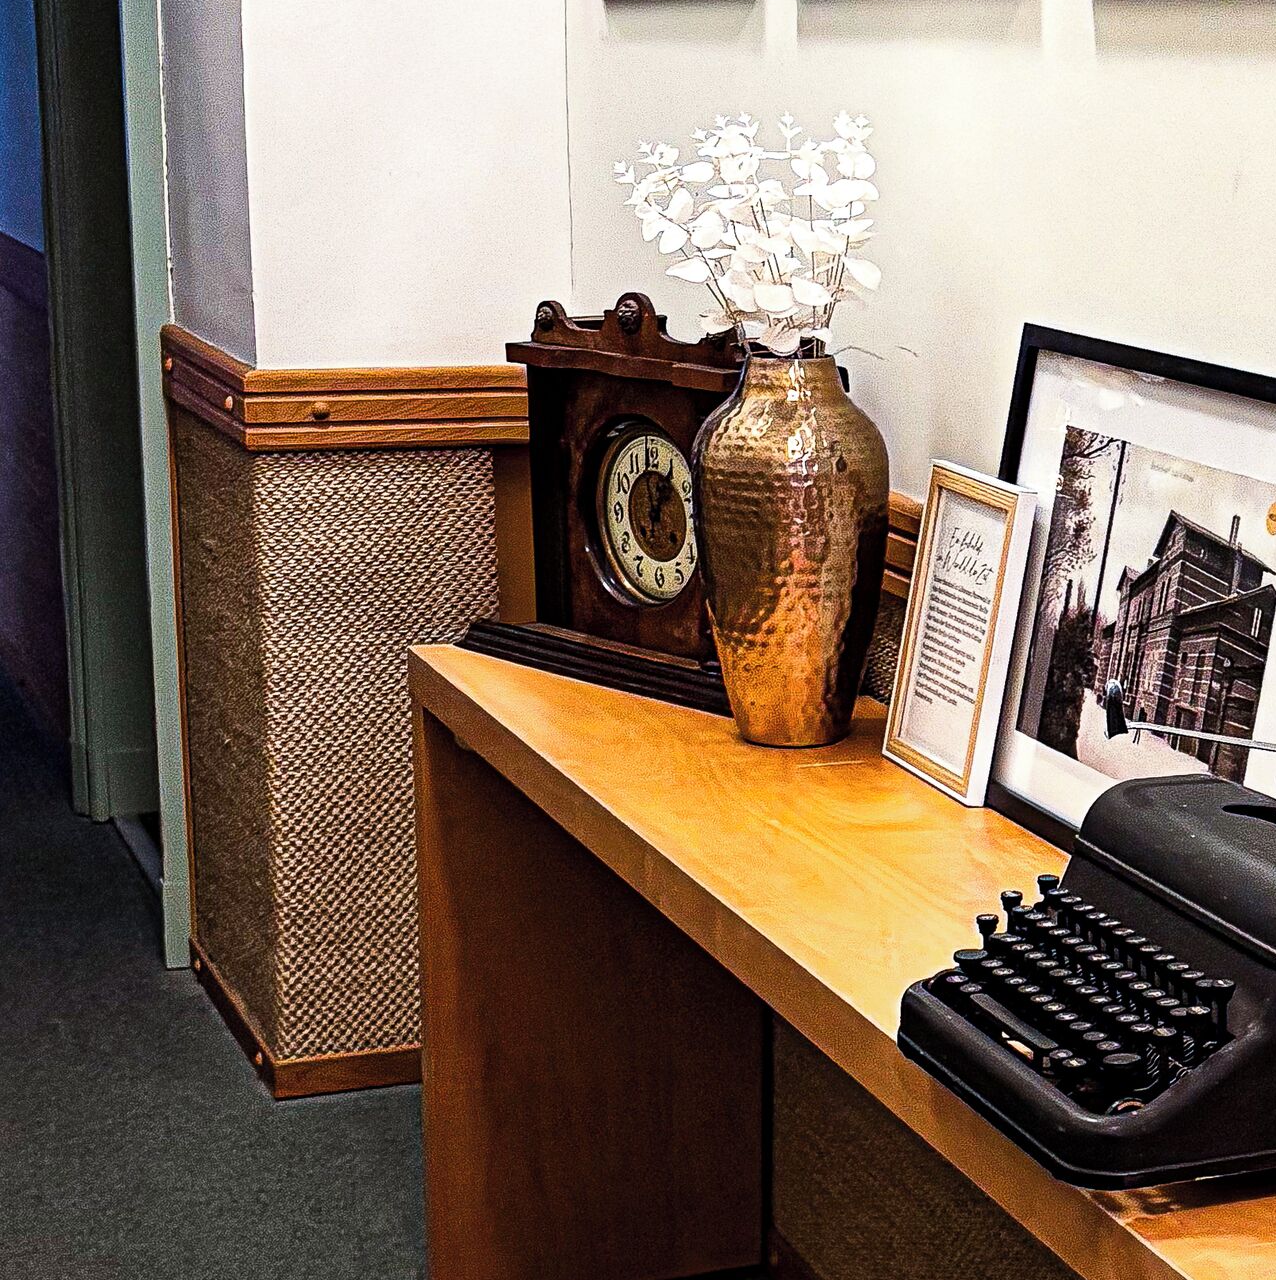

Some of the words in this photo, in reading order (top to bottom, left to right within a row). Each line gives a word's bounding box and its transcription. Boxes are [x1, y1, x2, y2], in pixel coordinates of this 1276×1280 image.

[629, 452, 640, 475] 11
[616, 472, 630, 495] 10
[613, 501, 624, 524] 9
[621, 531, 632, 554] 8
[632, 555, 644, 578] 7
[654, 565, 665, 589] 6
[674, 561, 685, 586] 5
